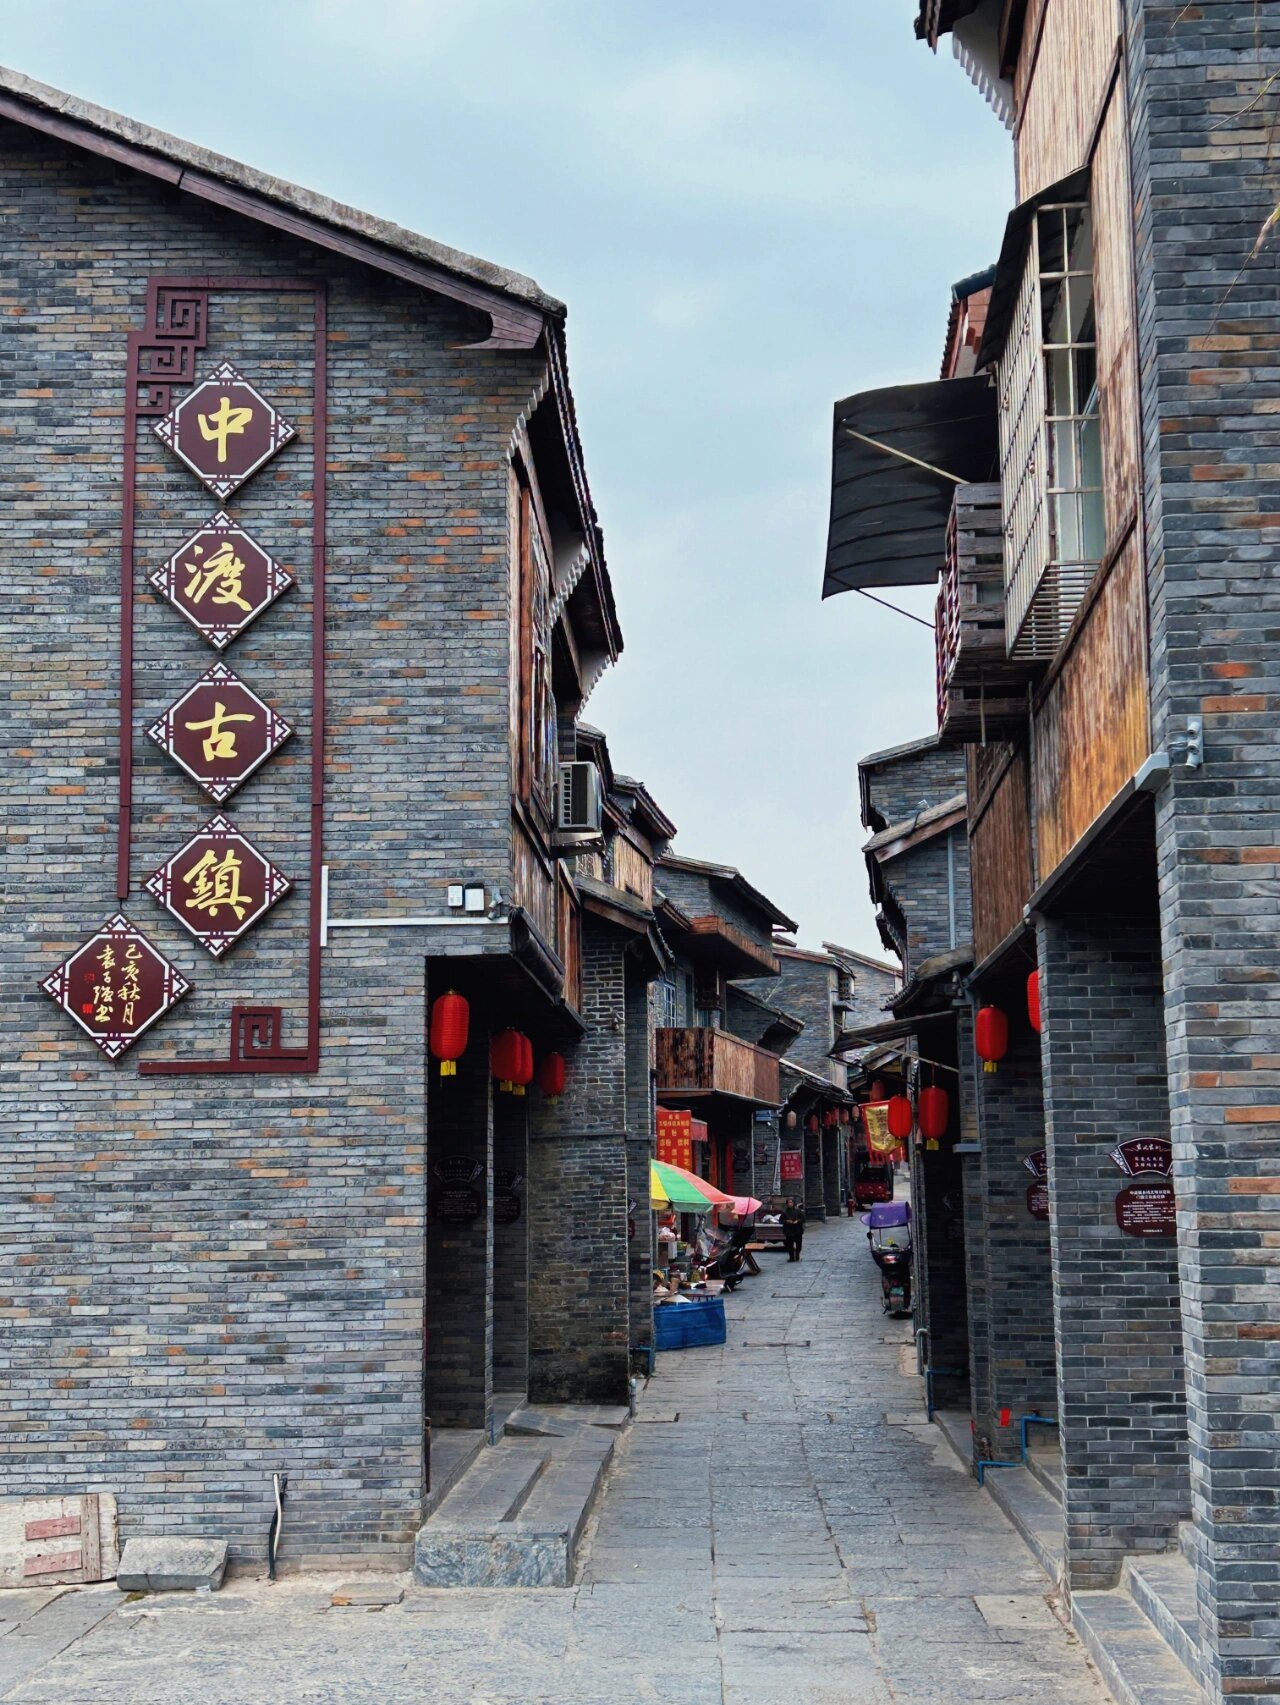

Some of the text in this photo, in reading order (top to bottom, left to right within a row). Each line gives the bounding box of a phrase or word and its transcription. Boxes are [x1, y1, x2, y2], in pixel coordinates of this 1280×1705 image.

[183, 399, 253, 920] 中渡古鎮
[117, 943, 143, 1026] 己亥秋月
